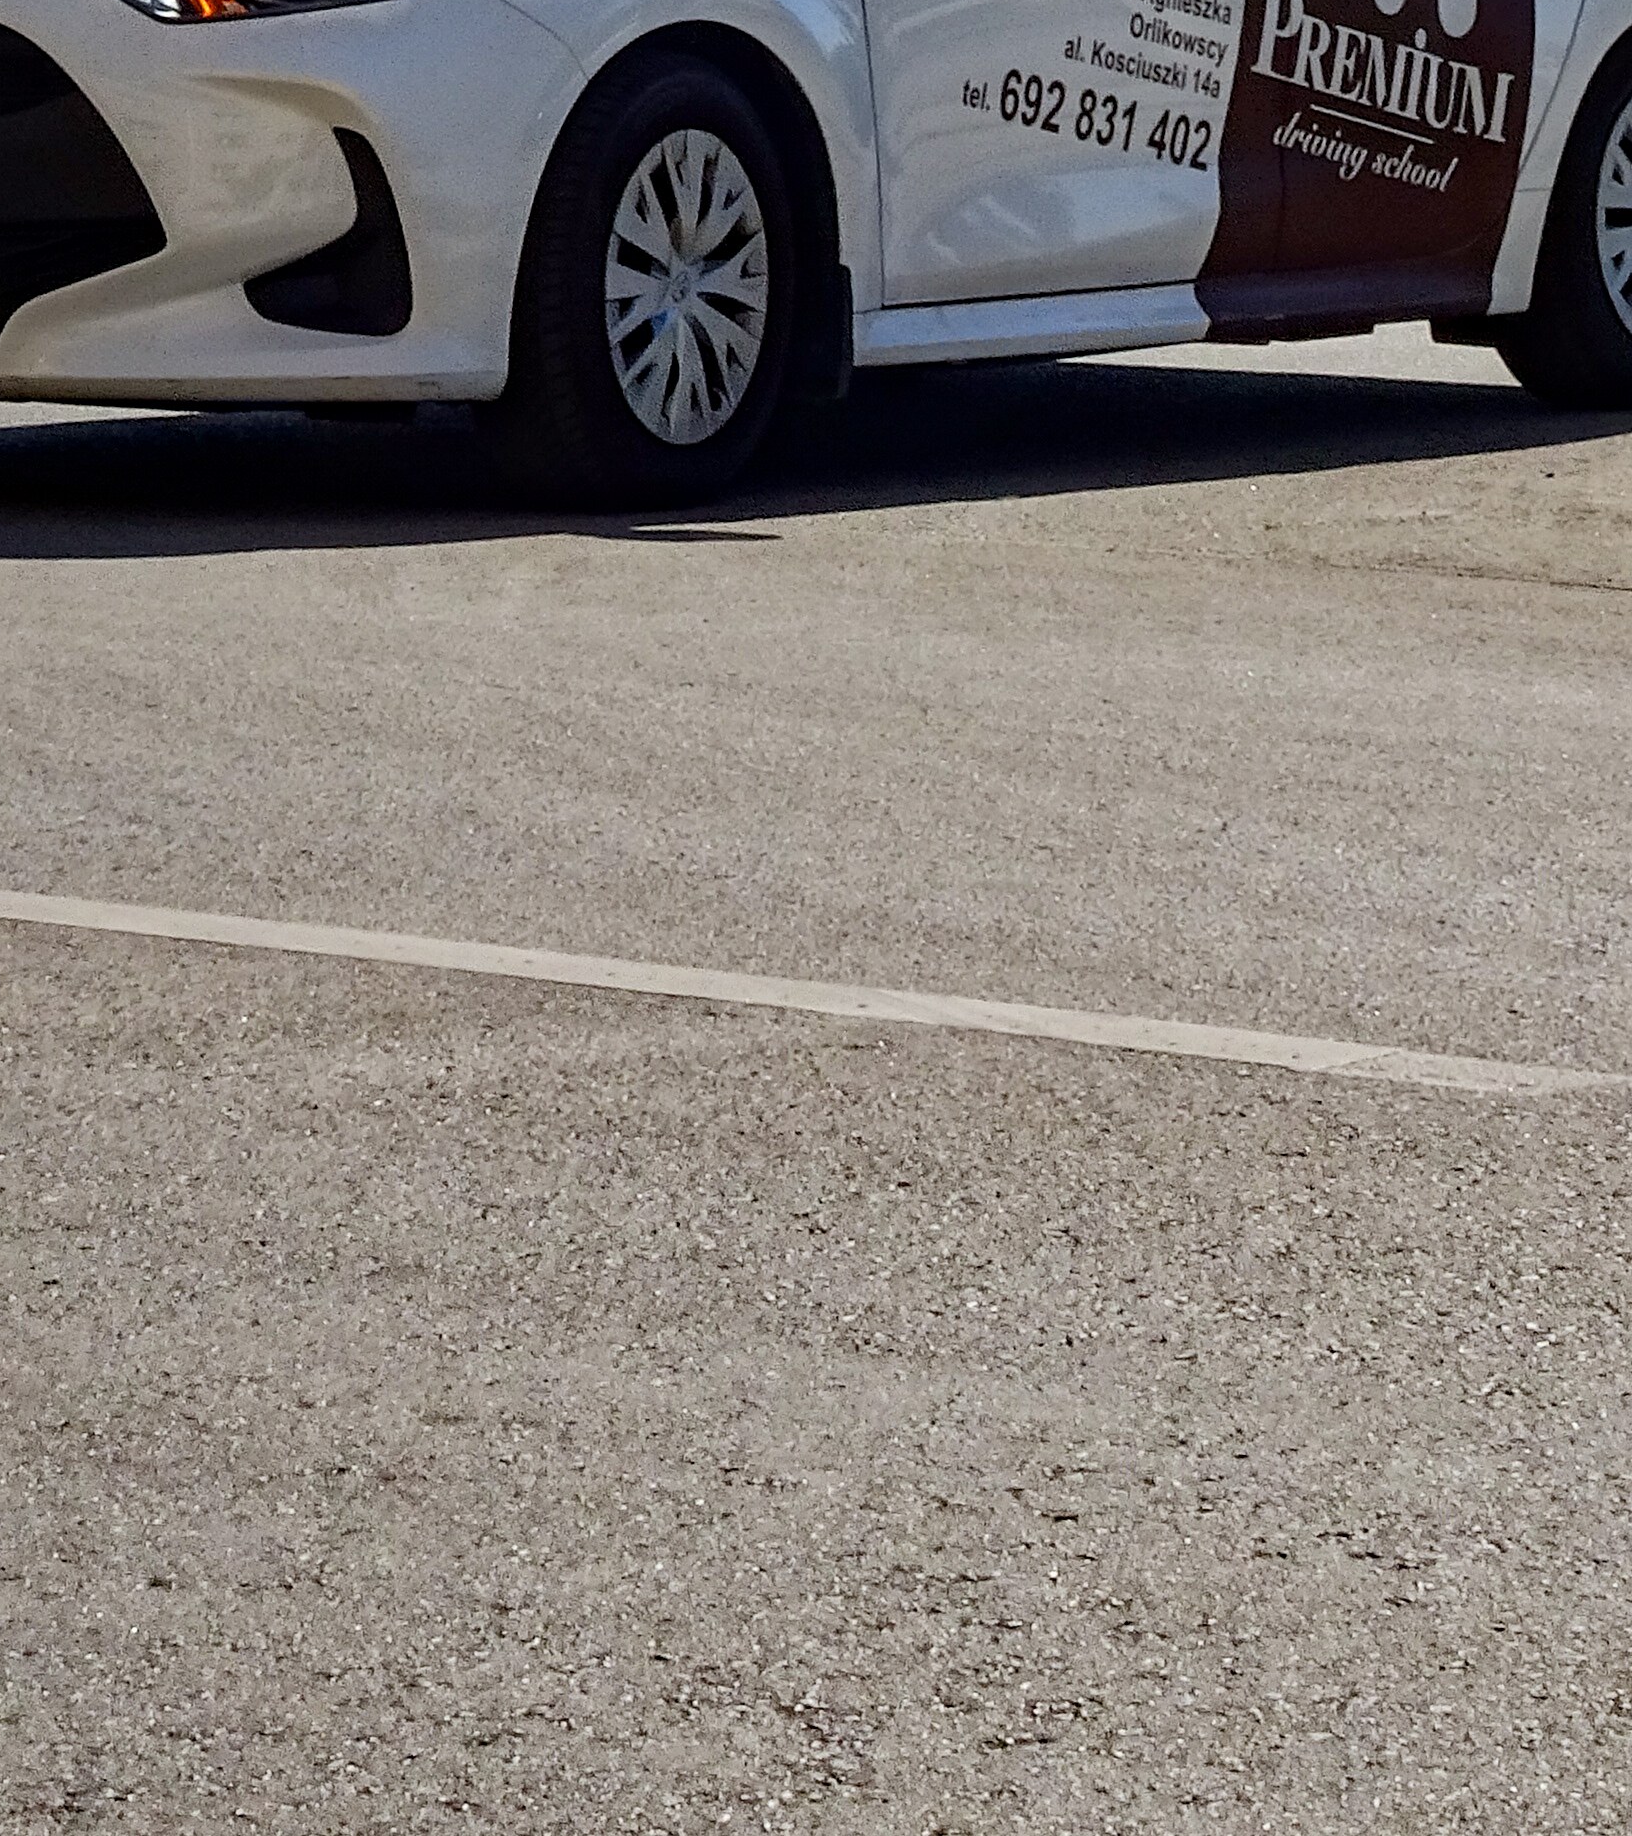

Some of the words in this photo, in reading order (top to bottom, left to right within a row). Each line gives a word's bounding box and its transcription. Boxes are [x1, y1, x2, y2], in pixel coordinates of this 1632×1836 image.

[1064, 36, 1086, 63] al.
[1192, 68, 1221, 99] 14a
[1129, 12, 1229, 68] Orlikowscy
[962, 79, 991, 112] tel.
[999, 69, 1066, 134] 692
[1074, 88, 1138, 152] 831
[1147, 109, 1211, 171] 402
[1273, 111, 1367, 181] driving
[1371, 144, 1459, 192] school
